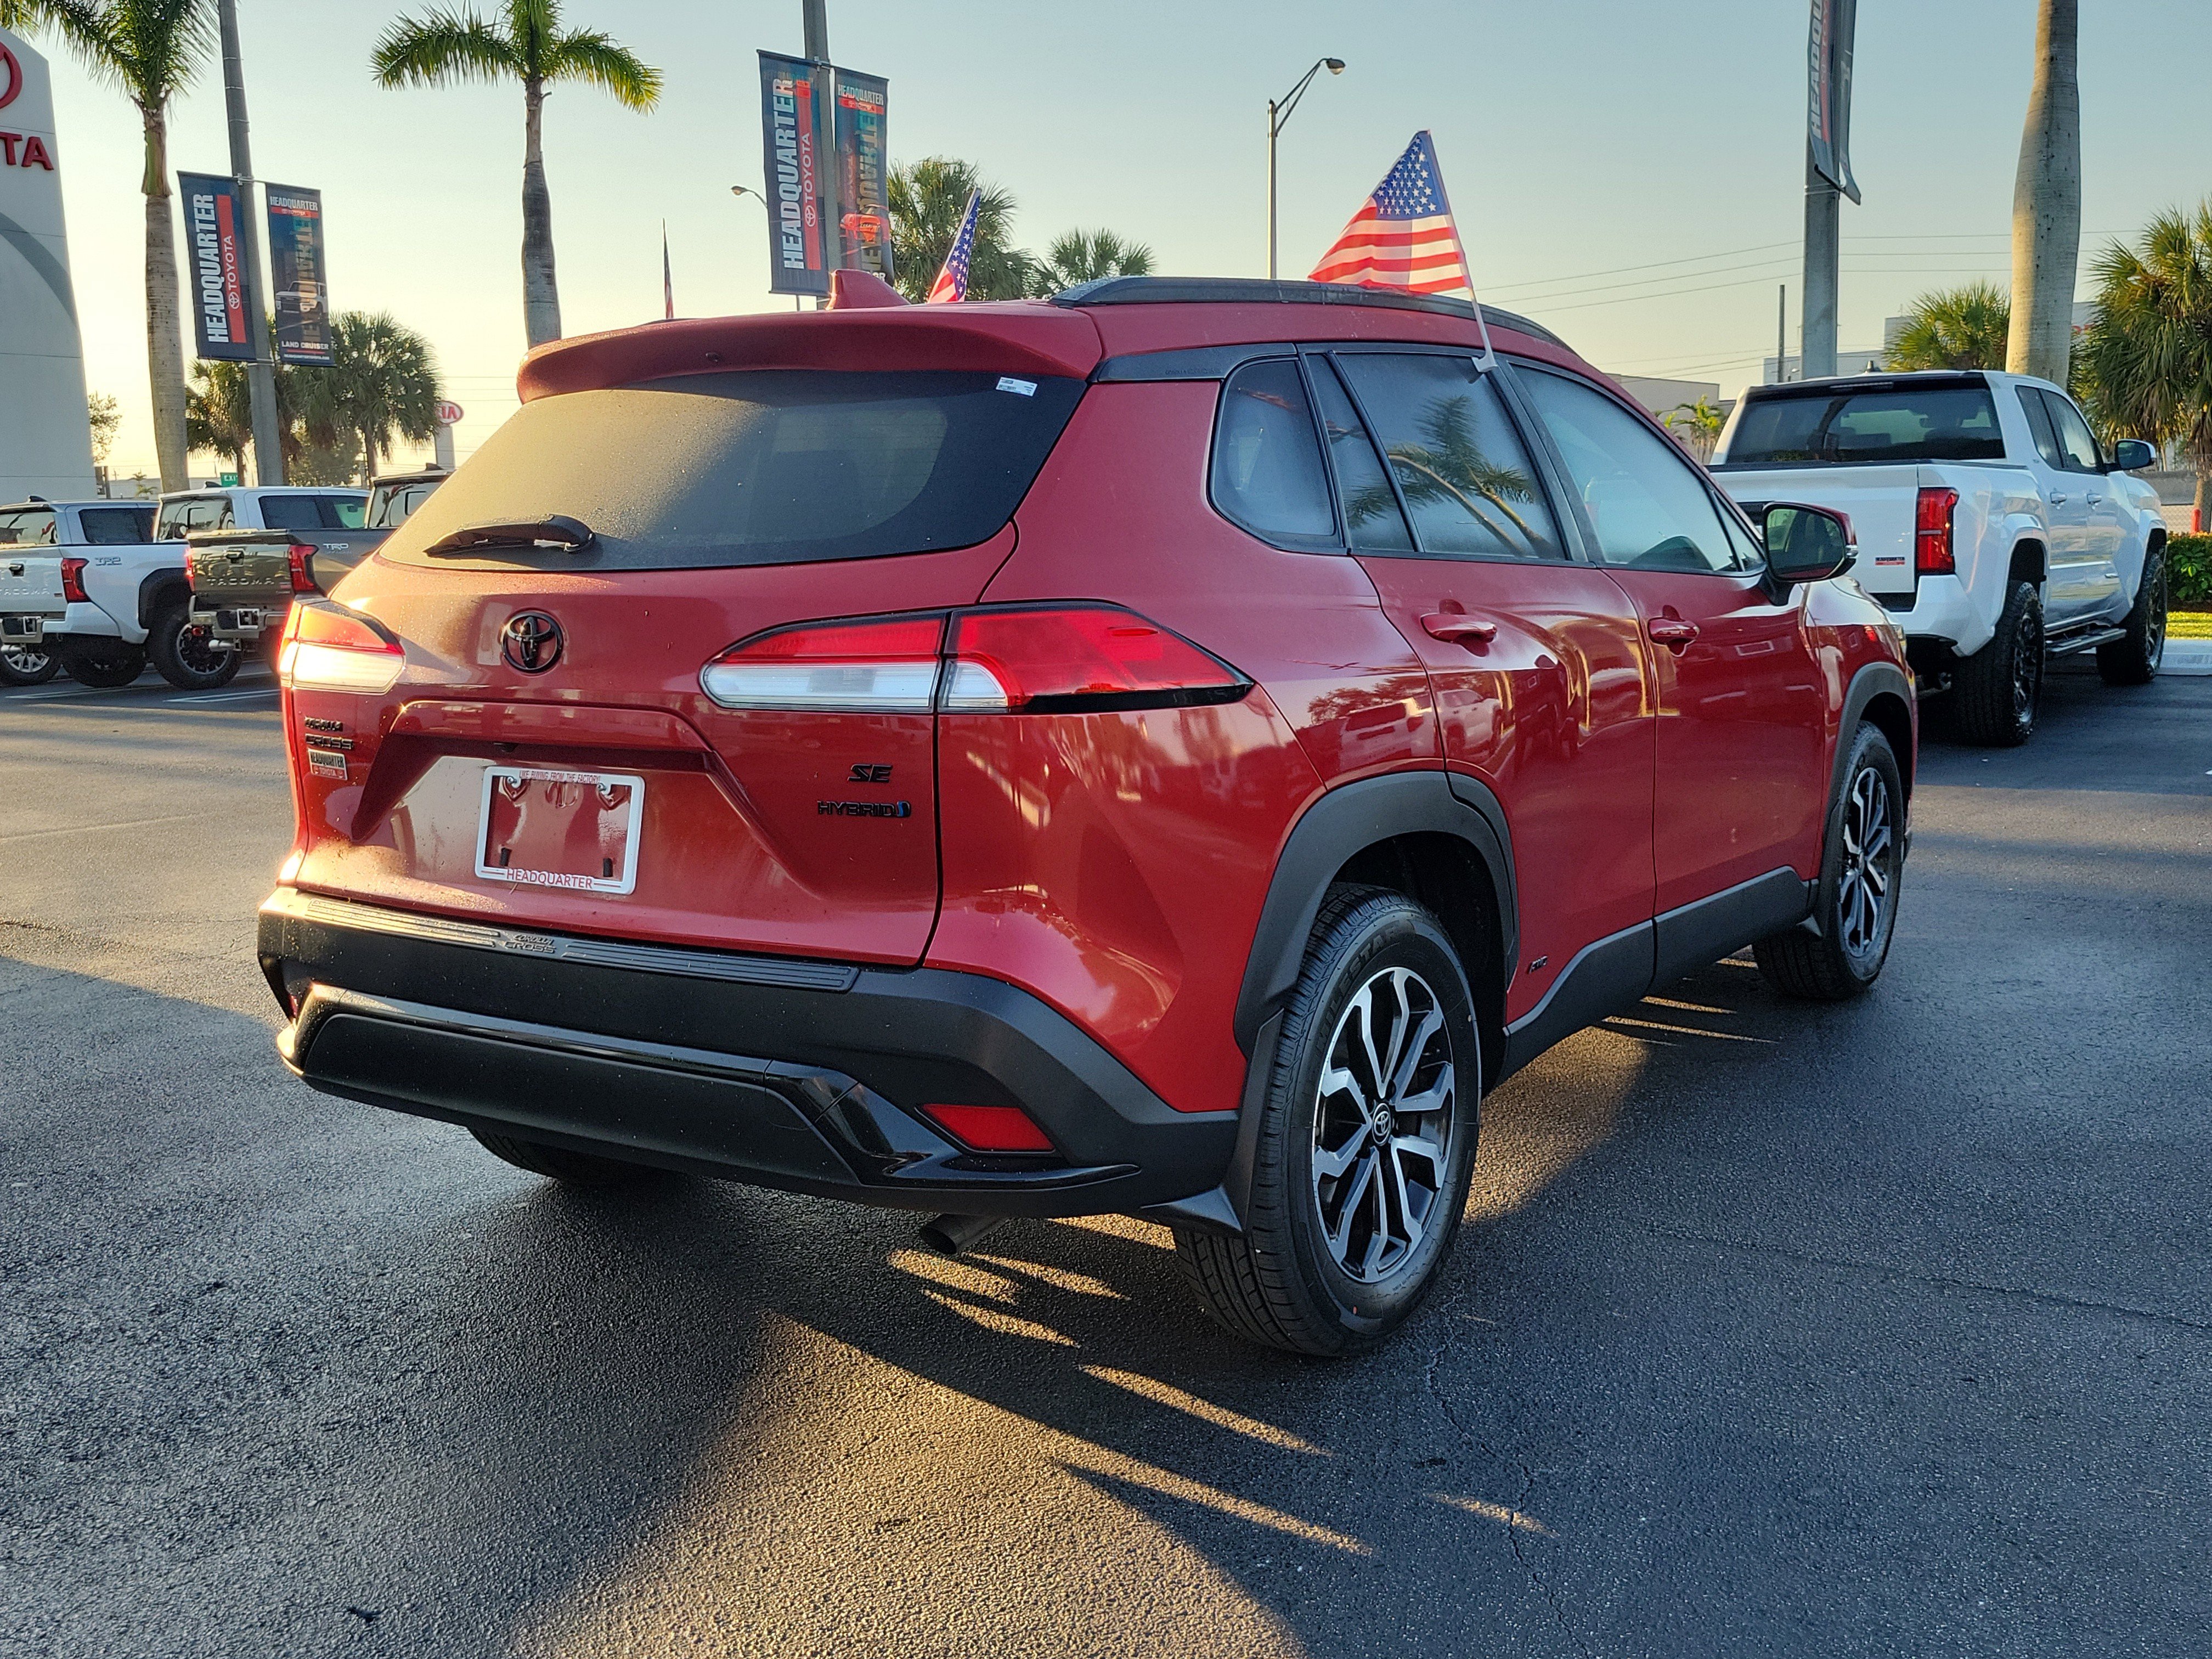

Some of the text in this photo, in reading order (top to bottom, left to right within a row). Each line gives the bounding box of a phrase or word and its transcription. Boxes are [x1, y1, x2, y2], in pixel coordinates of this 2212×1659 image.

[838, 83, 883, 106] HEADQUARTER
[772, 78, 805, 269] HEADQUARTER
[802, 133, 814, 202] TOYOTA
[270, 196, 318, 211] HEADQUARTER
[193, 194, 229, 343] HEADQUARTER
[224, 235, 238, 290] TOYOTA
[206, 578, 275, 586] TACOMA
[550, 772, 565, 781] FROM
[566, 773, 576, 782] THE
[847, 764, 893, 783] SE
[817, 800, 896, 816] HYBRID
[506, 868, 592, 889] HEADQUARTER
[504, 940, 556, 954] CROSS
